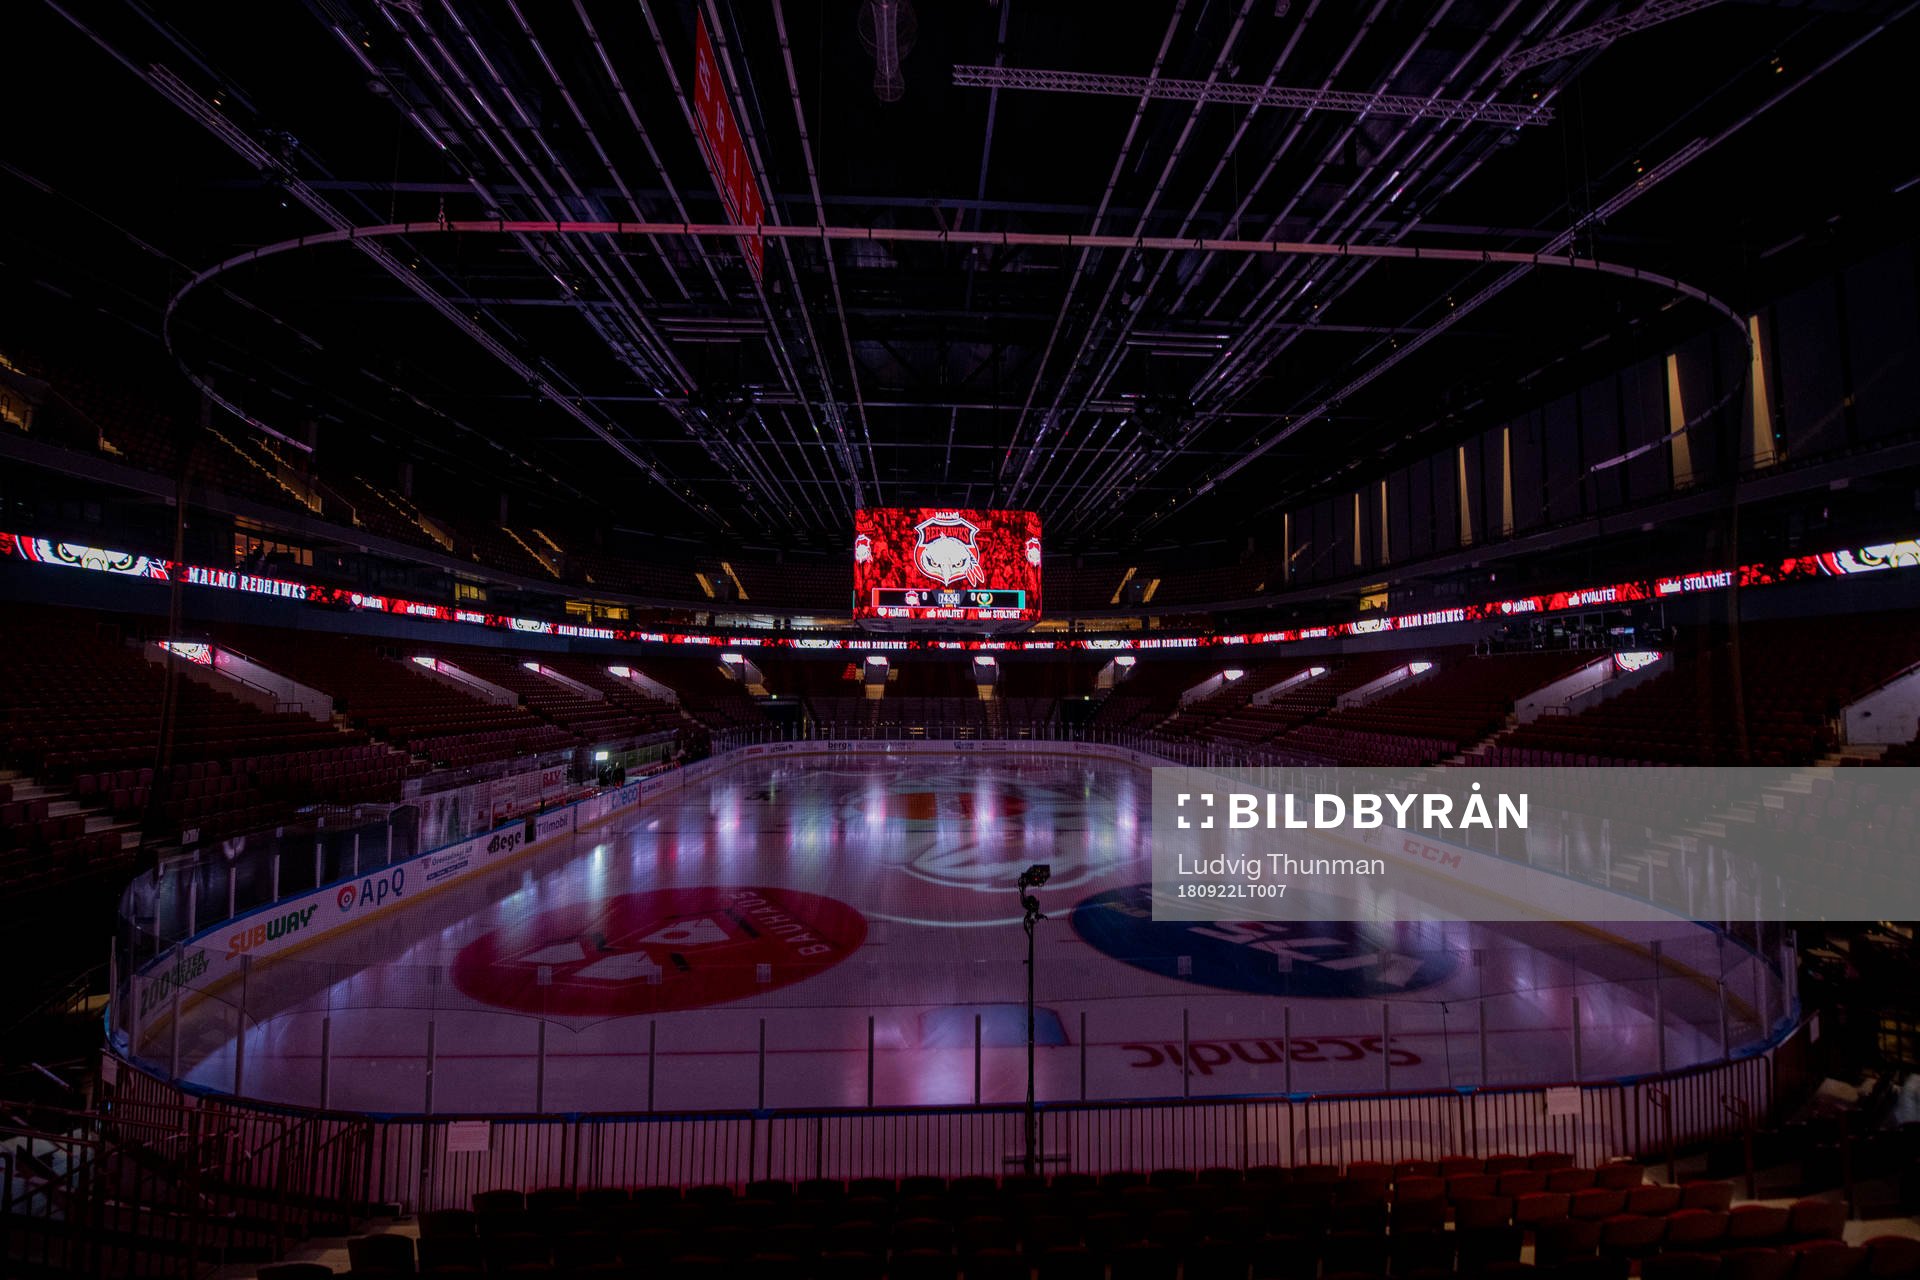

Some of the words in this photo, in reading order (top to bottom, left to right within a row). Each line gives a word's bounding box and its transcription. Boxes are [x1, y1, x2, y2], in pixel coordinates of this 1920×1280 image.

[188, 566, 236, 589] MALMÖ
[240, 575, 306, 599] REDHAWKS
[1581, 588, 1616, 604] KVALITET
[1683, 571, 1732, 591] STOLTHET
[937, 609, 964, 618] KVALITET
[992, 609, 1021, 619] STOLTHET
[1403, 838, 1463, 869] CCM
[225, 903, 318, 960] SUBWAY
[729, 891, 832, 956] BAUHAUS
[1122, 1037, 1422, 1076] Scandic
